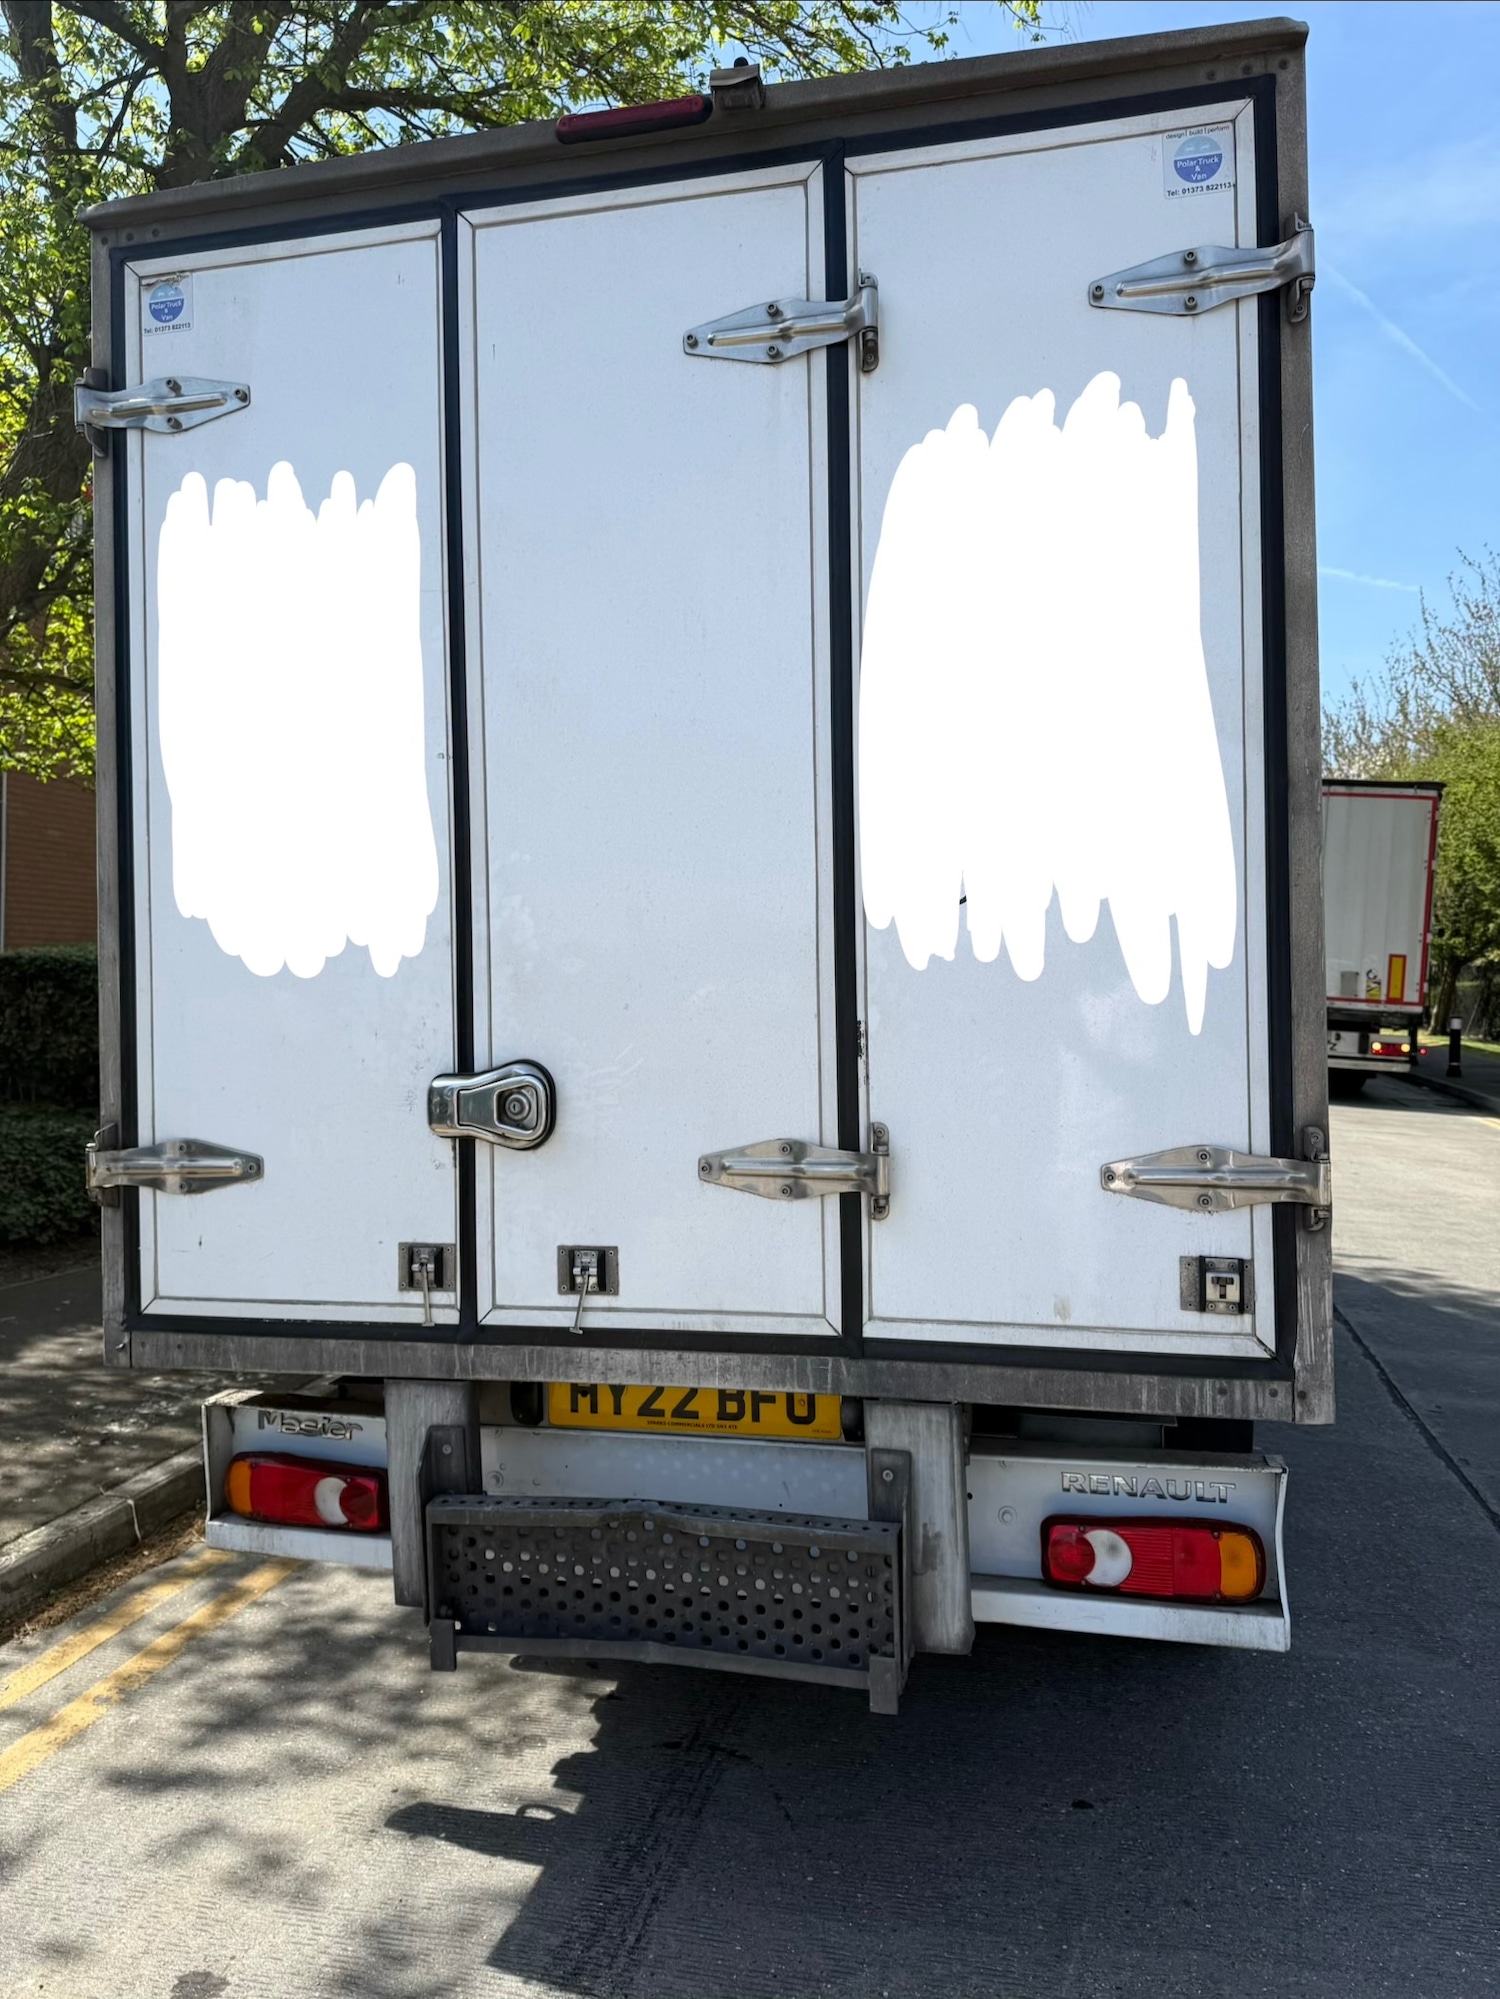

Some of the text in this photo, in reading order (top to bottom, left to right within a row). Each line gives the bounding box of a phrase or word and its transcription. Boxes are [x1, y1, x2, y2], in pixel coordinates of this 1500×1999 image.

[1208, 125, 1230, 134] perform
[1177, 156, 1219, 168] Polar Truck
[1191, 173, 1207, 181] Van
[1167, 182, 1232, 197] Tel: 01373 822113
[166, 300, 182, 308] Truck
[172, 322, 190, 330] 822113
[258, 1410, 363, 1440] Master
[1061, 1471, 1236, 1504] RENAULT
